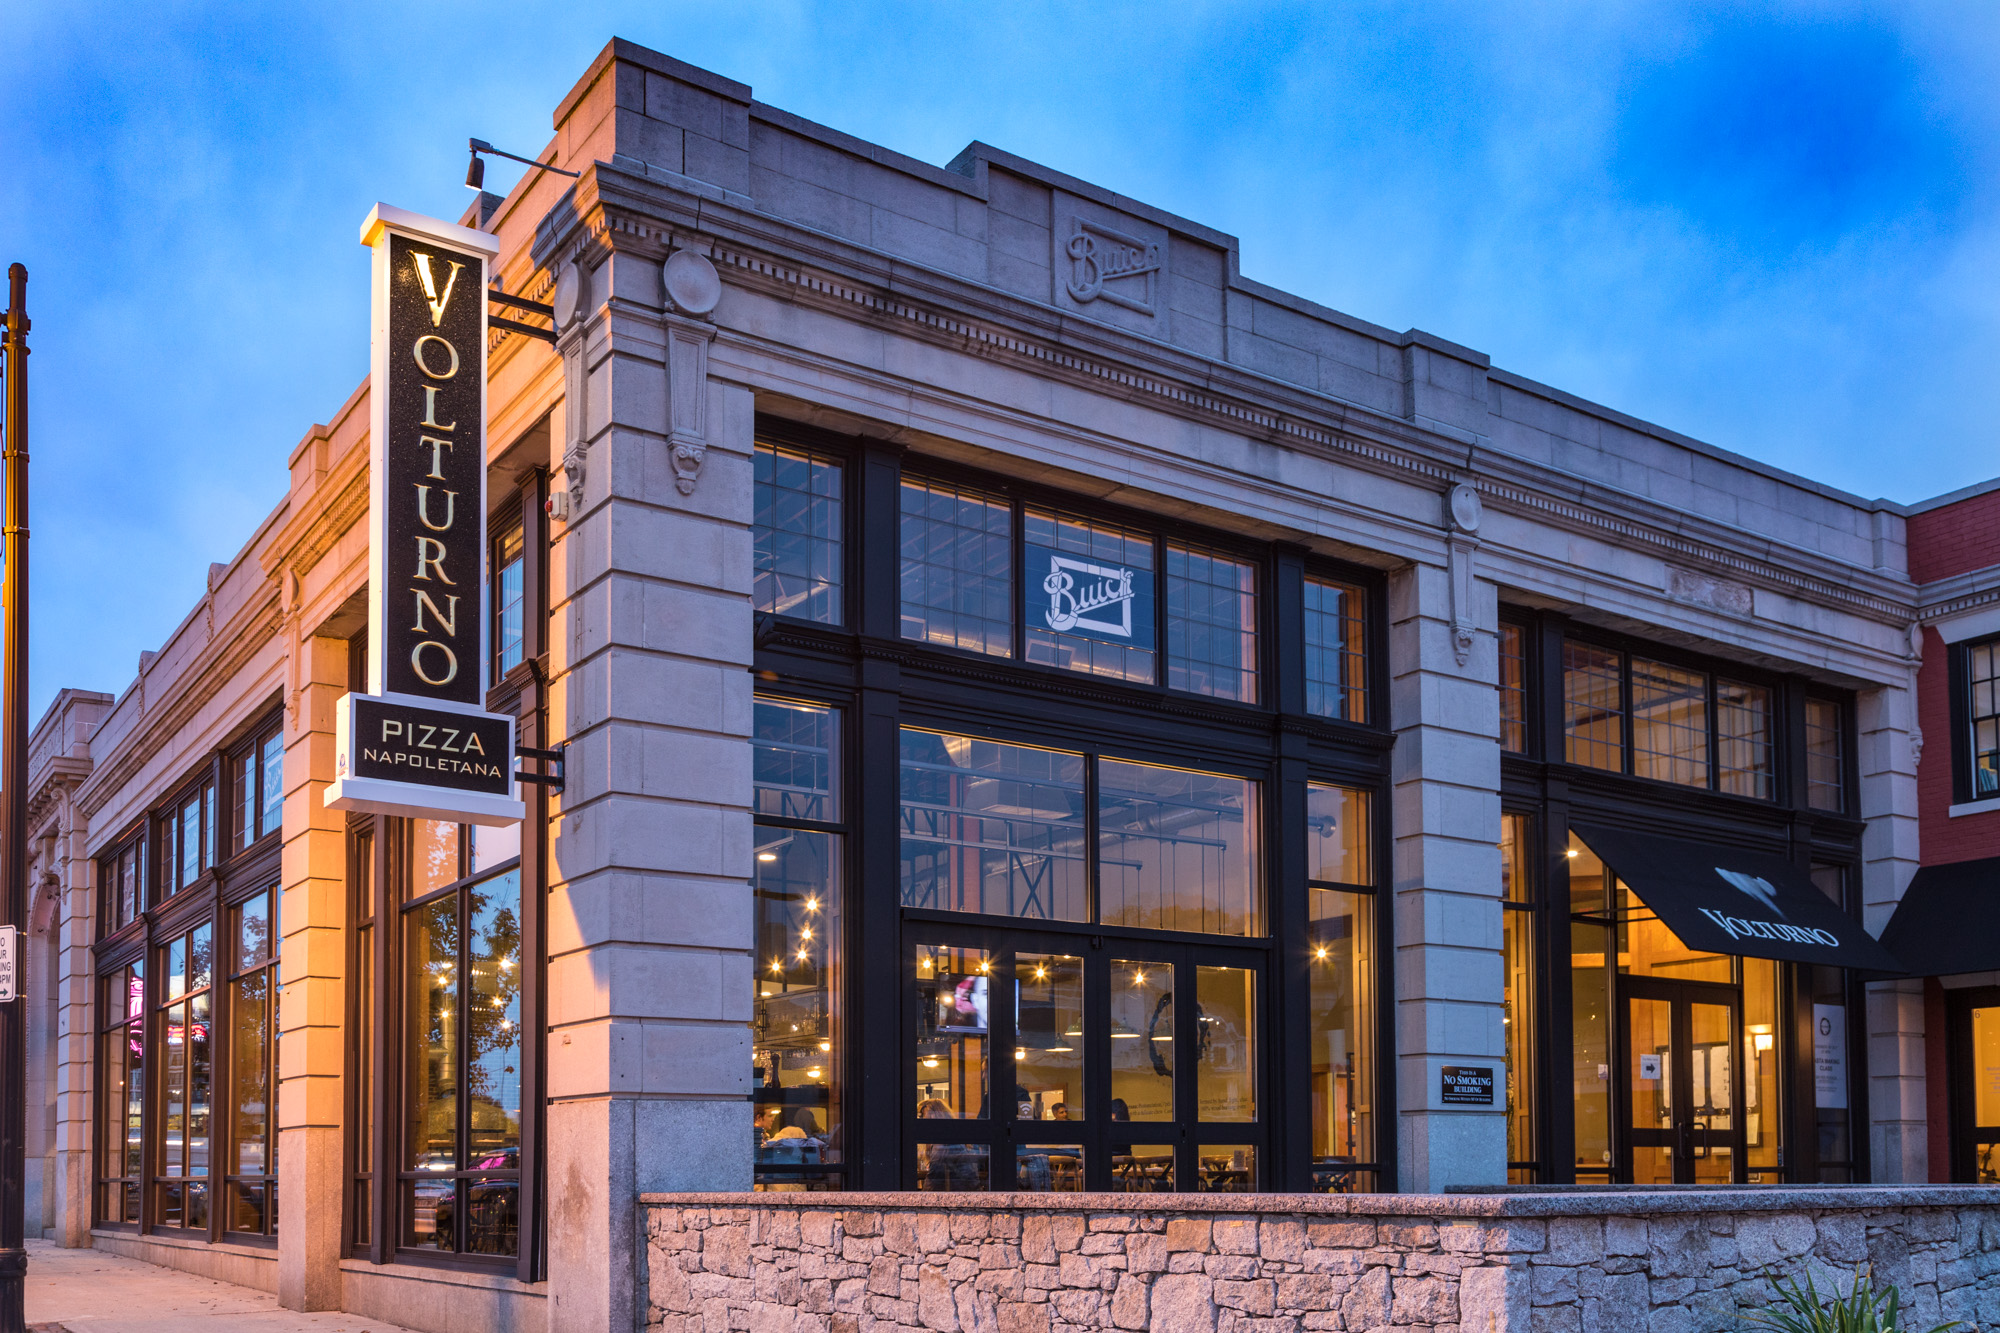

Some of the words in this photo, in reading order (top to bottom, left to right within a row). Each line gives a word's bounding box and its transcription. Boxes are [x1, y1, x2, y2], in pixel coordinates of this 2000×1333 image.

[1066, 233, 1160, 304] Buick
[408, 249, 466, 687] VOLTURNO
[1043, 567, 1135, 631] Buick
[382, 719, 485, 756] PIZZA
[364, 748, 502, 778] NAPOLETANA
[1697, 907, 1840, 947] VOLTURNO
[1453, 1085, 1482, 1093] BUILDING
[1457, 1075, 1491, 1086] SMOKING
